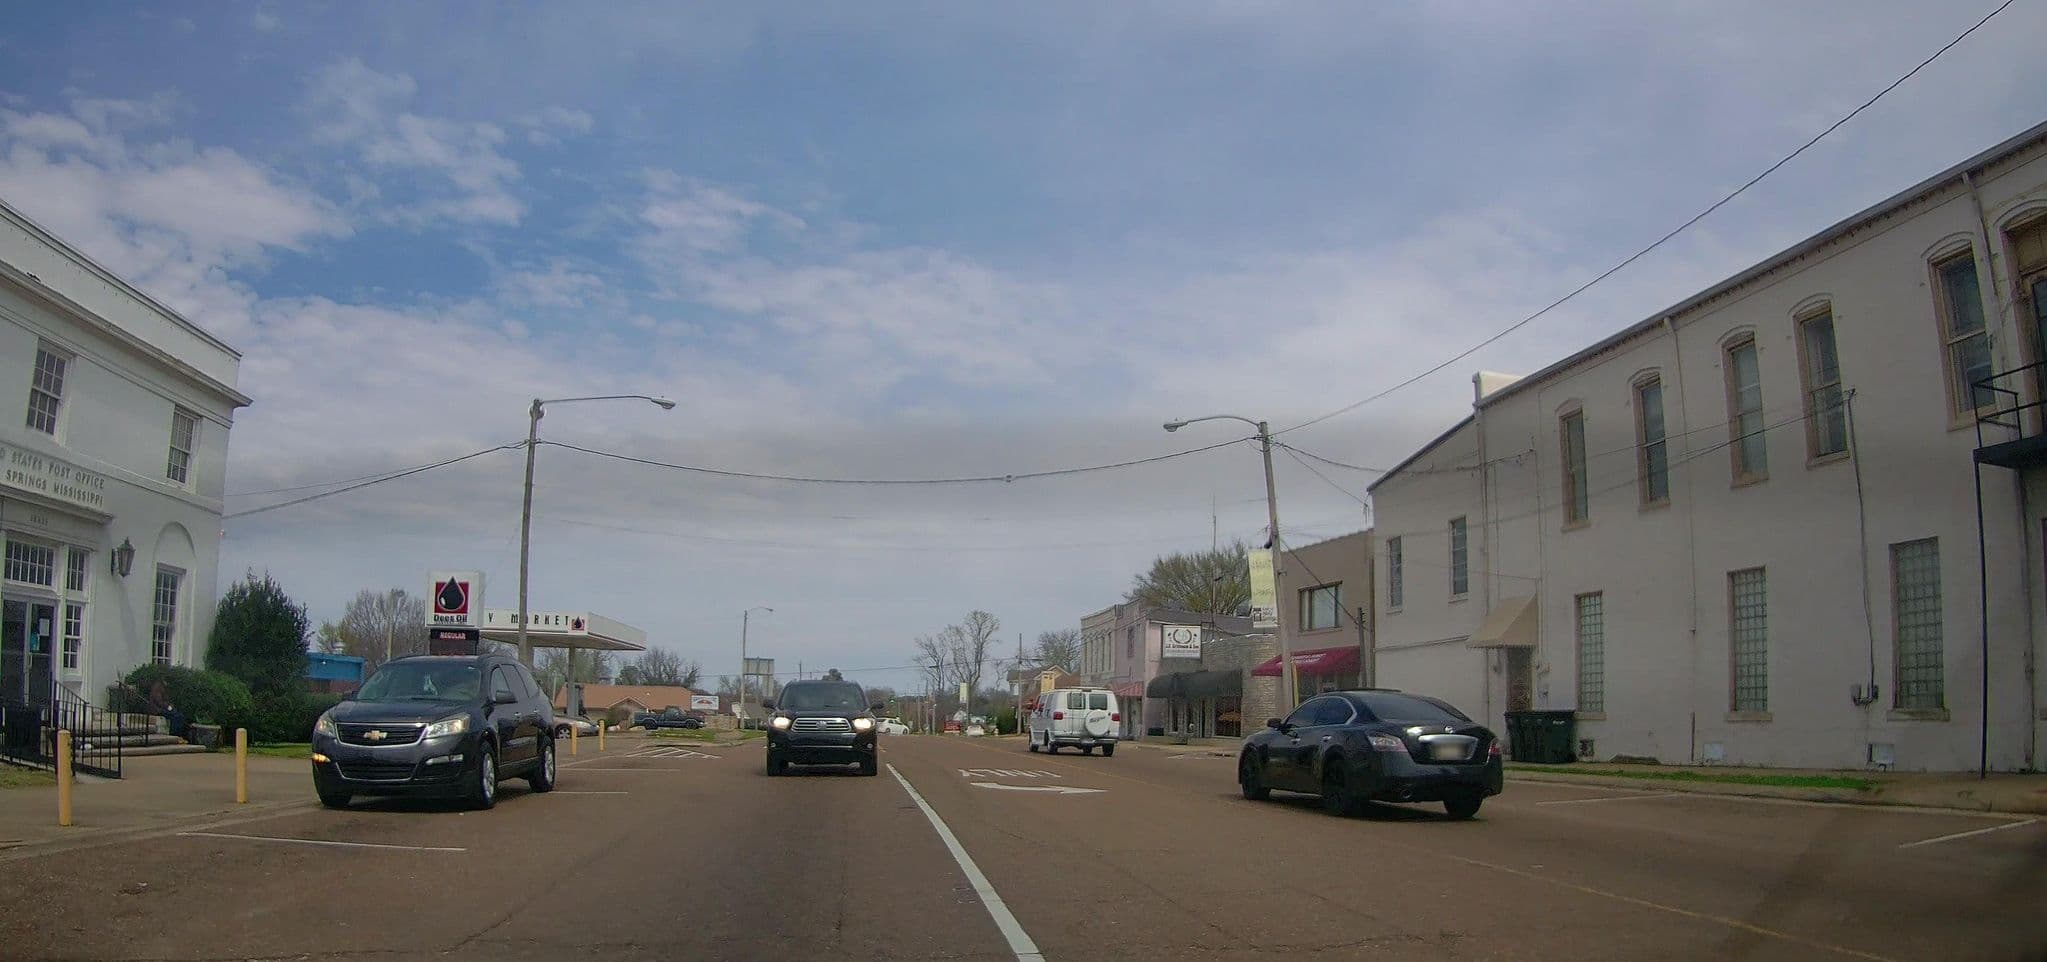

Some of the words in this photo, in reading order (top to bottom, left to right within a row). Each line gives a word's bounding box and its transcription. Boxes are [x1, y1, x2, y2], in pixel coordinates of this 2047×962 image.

[6, 469, 47, 490] SPRINGS
[53, 481, 104, 508] MISSISSIPPI
[12, 451, 42, 471] STATES
[48, 461, 71, 479] POST
[75, 471, 105, 489] OFFICE
[440, 631, 466, 640] REGULAR
